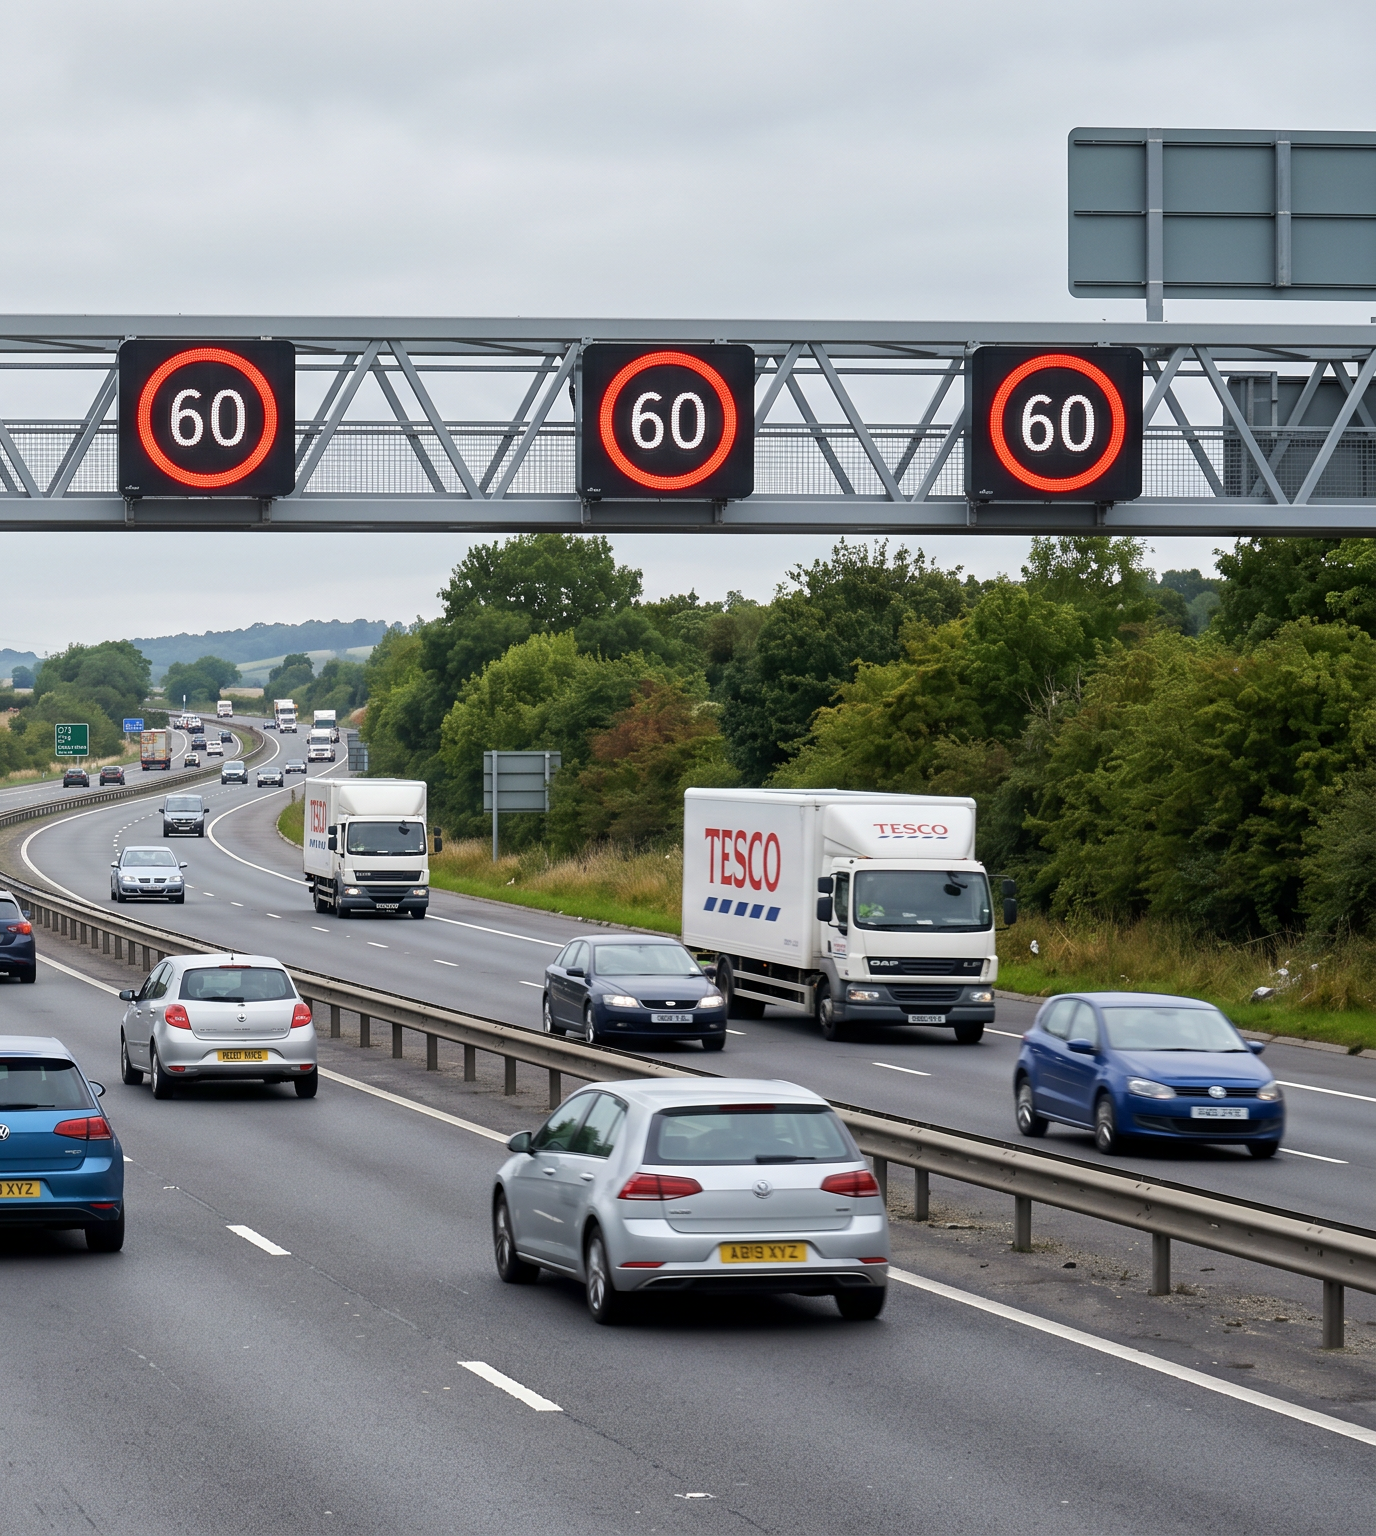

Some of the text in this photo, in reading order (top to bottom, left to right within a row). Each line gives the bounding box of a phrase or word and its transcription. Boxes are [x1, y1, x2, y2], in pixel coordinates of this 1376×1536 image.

[170, 388, 246, 447] 60
[631, 391, 706, 450] 60
[1021, 394, 1096, 453] 60
[873, 823, 949, 835] TESCO
[705, 827, 781, 893] TESCO
[6, 1182, 34, 1195] XYZ
[768, 1244, 798, 1259] XYZ
